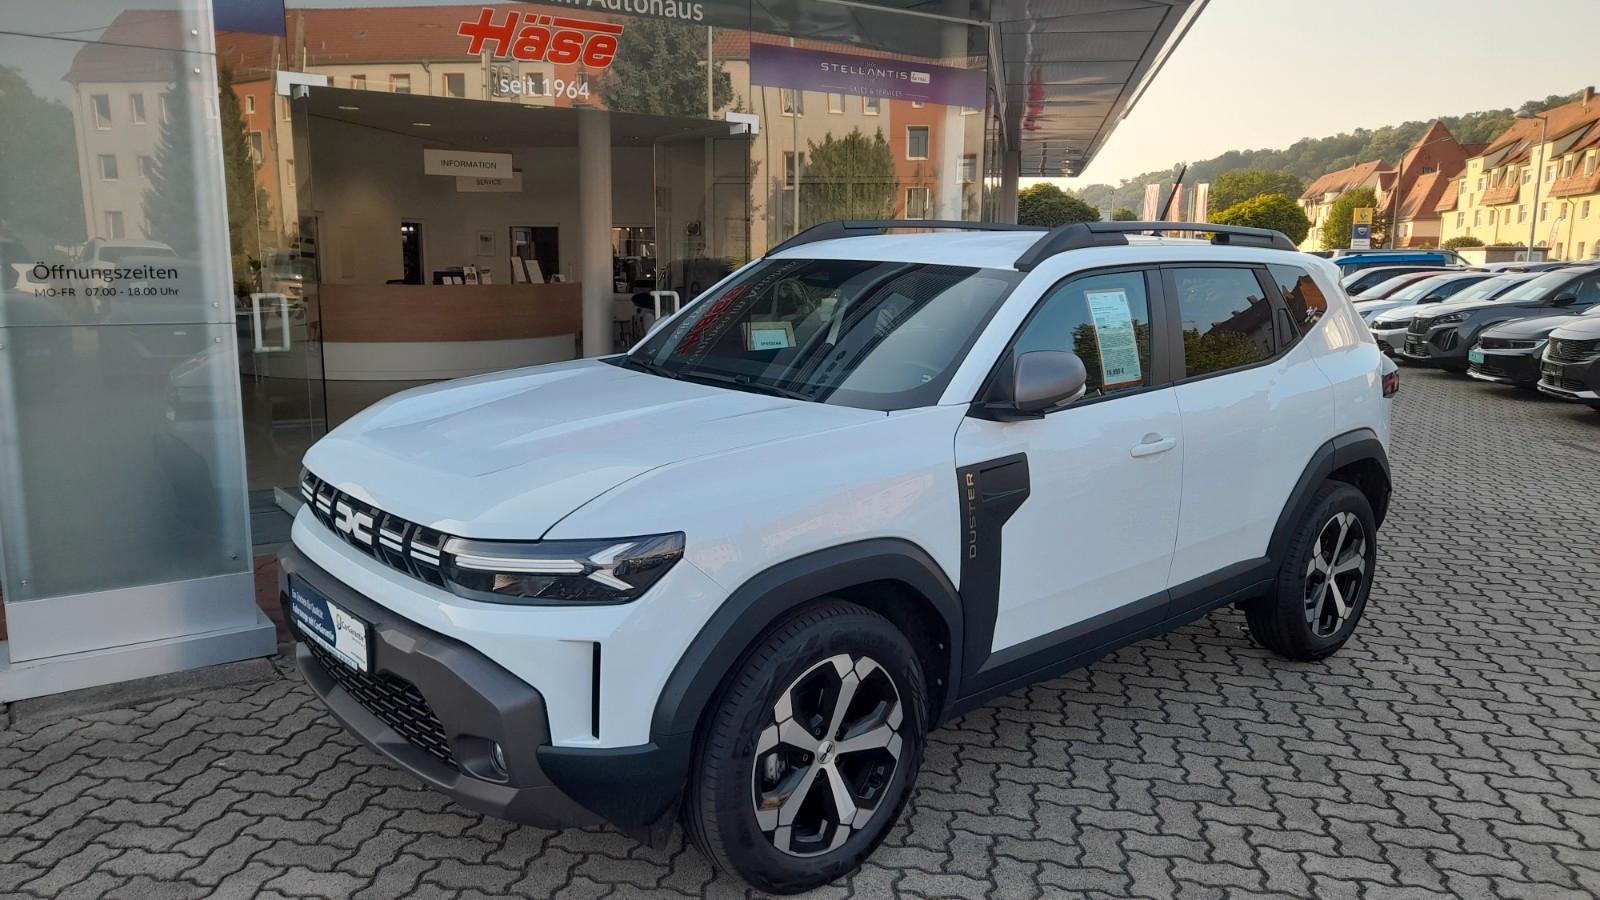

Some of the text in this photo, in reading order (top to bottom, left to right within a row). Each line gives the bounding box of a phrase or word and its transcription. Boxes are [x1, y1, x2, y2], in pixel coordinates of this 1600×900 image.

[457, 7, 625, 69] Häse
[820, 62, 908, 81] STELLANTIS
[499, 76, 590, 99] seit 1964
[440, 160, 497, 169] INFORMATION
[32, 261, 178, 283] Öffnungszeiten
[34, 288, 76, 297] MO-FR
[85, 288, 116, 297] 07.00
[128, 287, 157, 297] 18.00
[160, 287, 180, 296] Uhr
[966, 472, 977, 559] DUSTER
